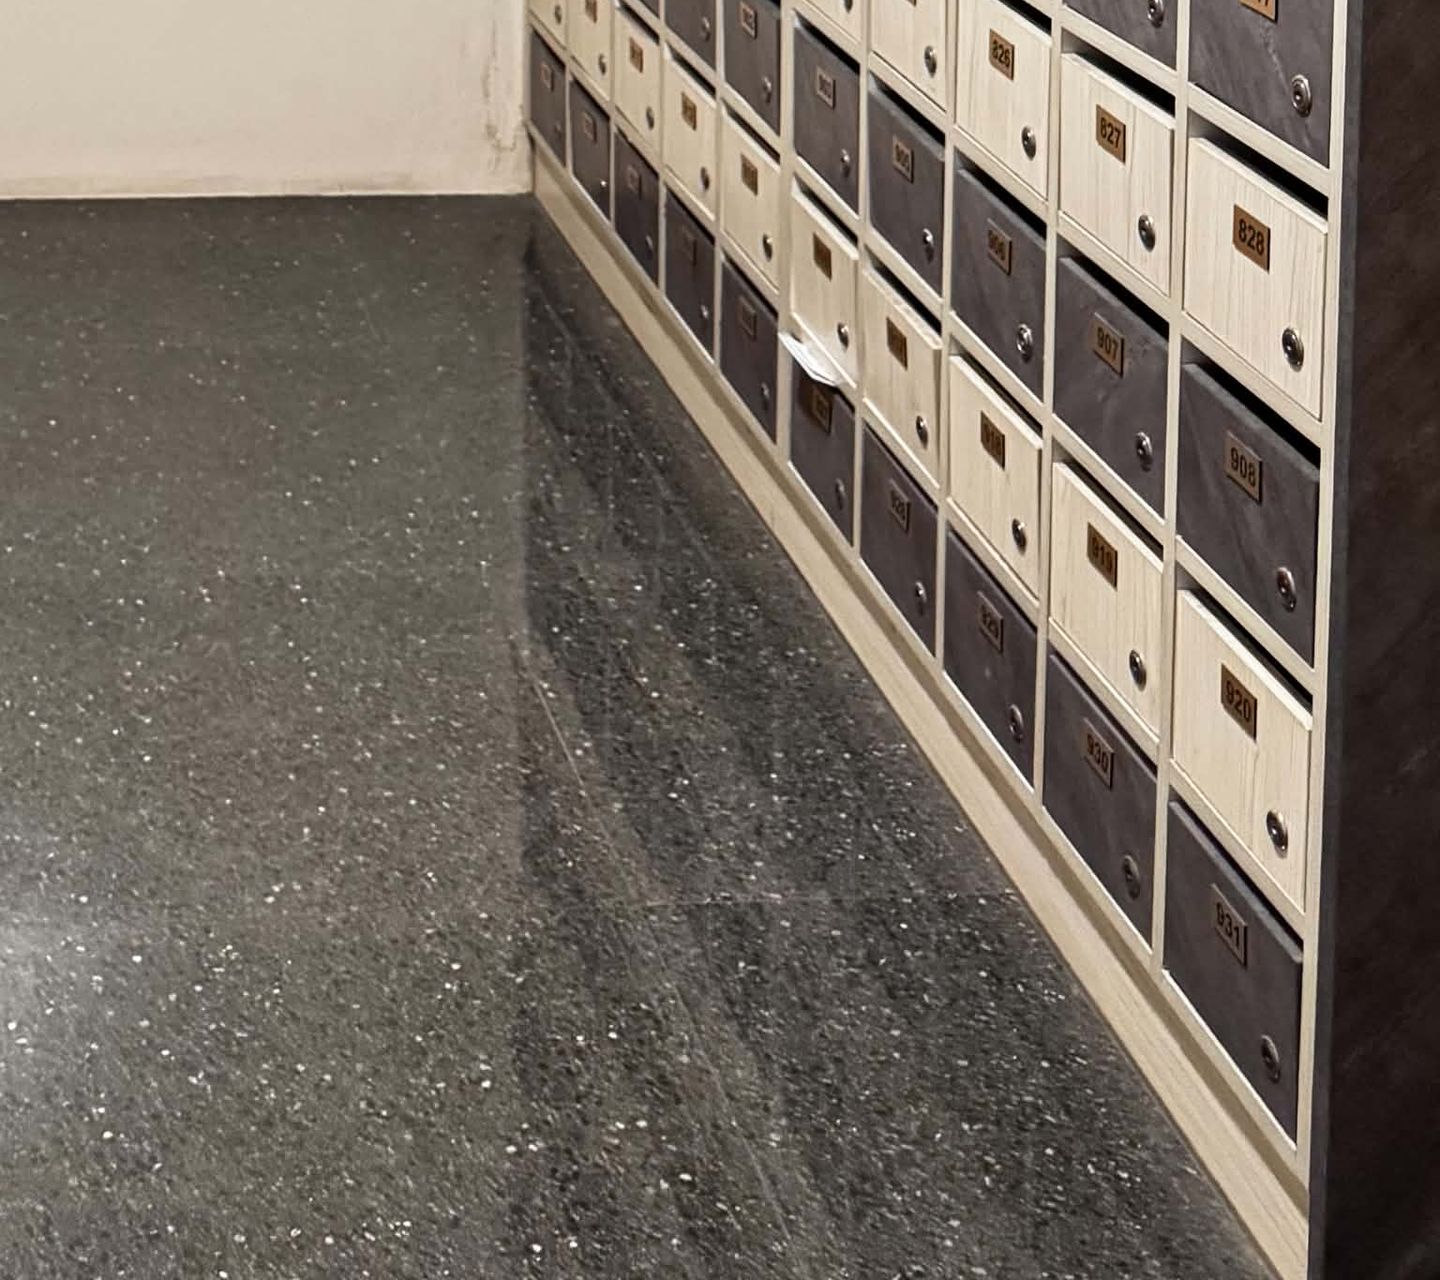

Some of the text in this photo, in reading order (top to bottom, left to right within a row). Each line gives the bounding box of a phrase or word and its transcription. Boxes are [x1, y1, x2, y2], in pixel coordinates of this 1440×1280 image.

[992, 40, 1010, 67] 826
[1101, 121, 1120, 151] 827
[1239, 223, 1265, 255] 828
[1098, 329, 1119, 361] 907
[1231, 449, 1256, 487] 908
[1226, 681, 1251, 719] 920
[1087, 737, 1108, 772] 930
[1217, 908, 1240, 948] 931
